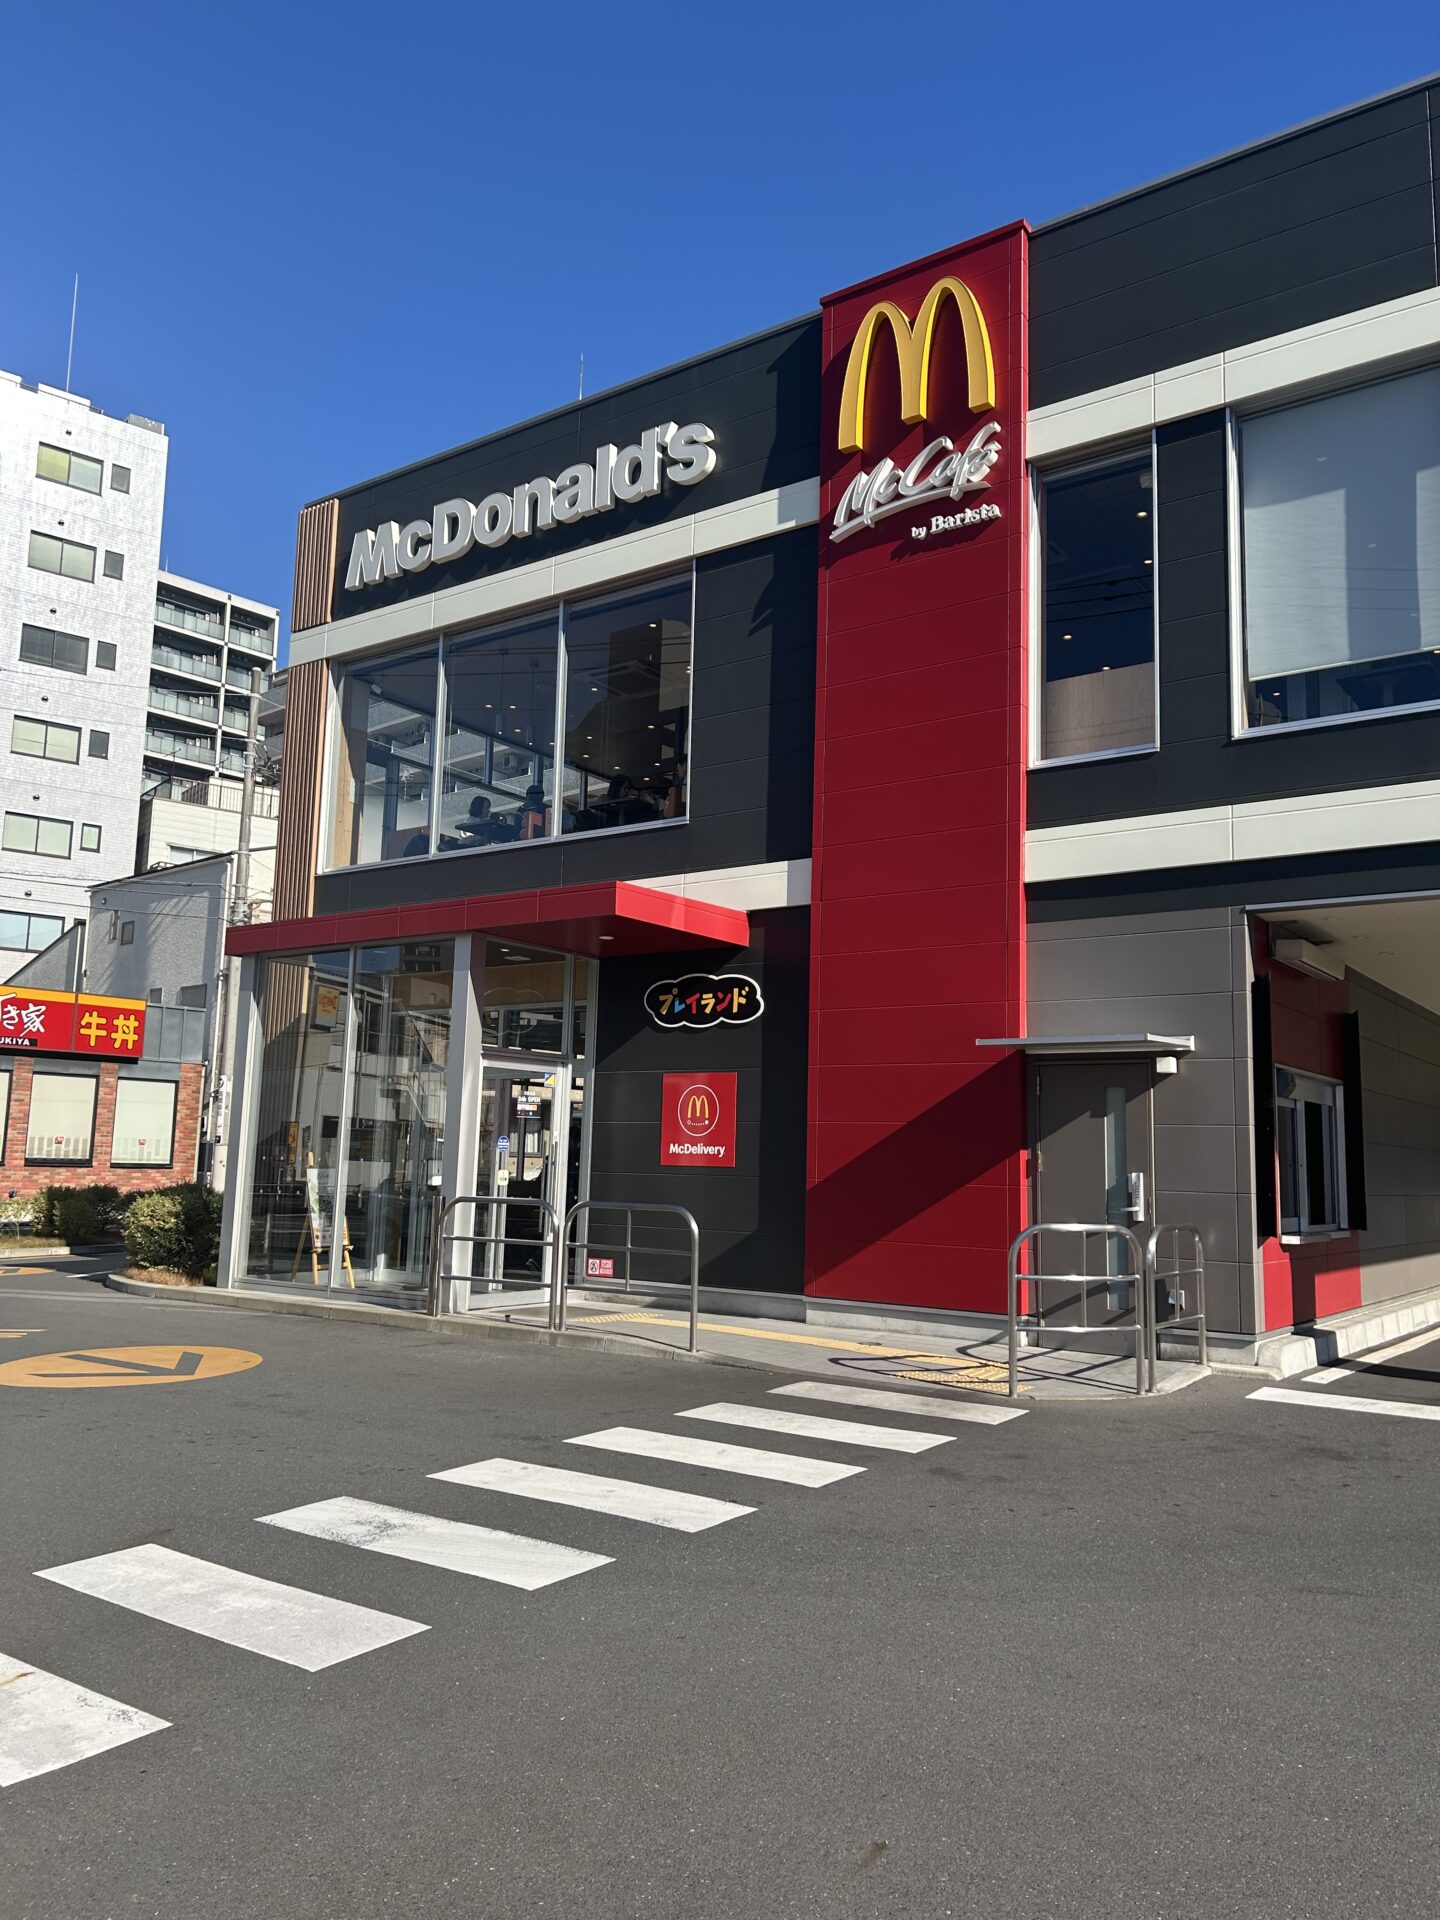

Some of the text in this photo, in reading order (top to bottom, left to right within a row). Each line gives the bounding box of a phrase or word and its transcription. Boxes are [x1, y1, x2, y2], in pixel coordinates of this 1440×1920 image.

[344, 421, 717, 591] McDonald's
[911, 504, 1002, 540] by Barista
[658, 986, 750, 1015] プレイランド
[80, 1010, 139, 1050] 牛丼
[669, 1142, 726, 1158] McDelivery
